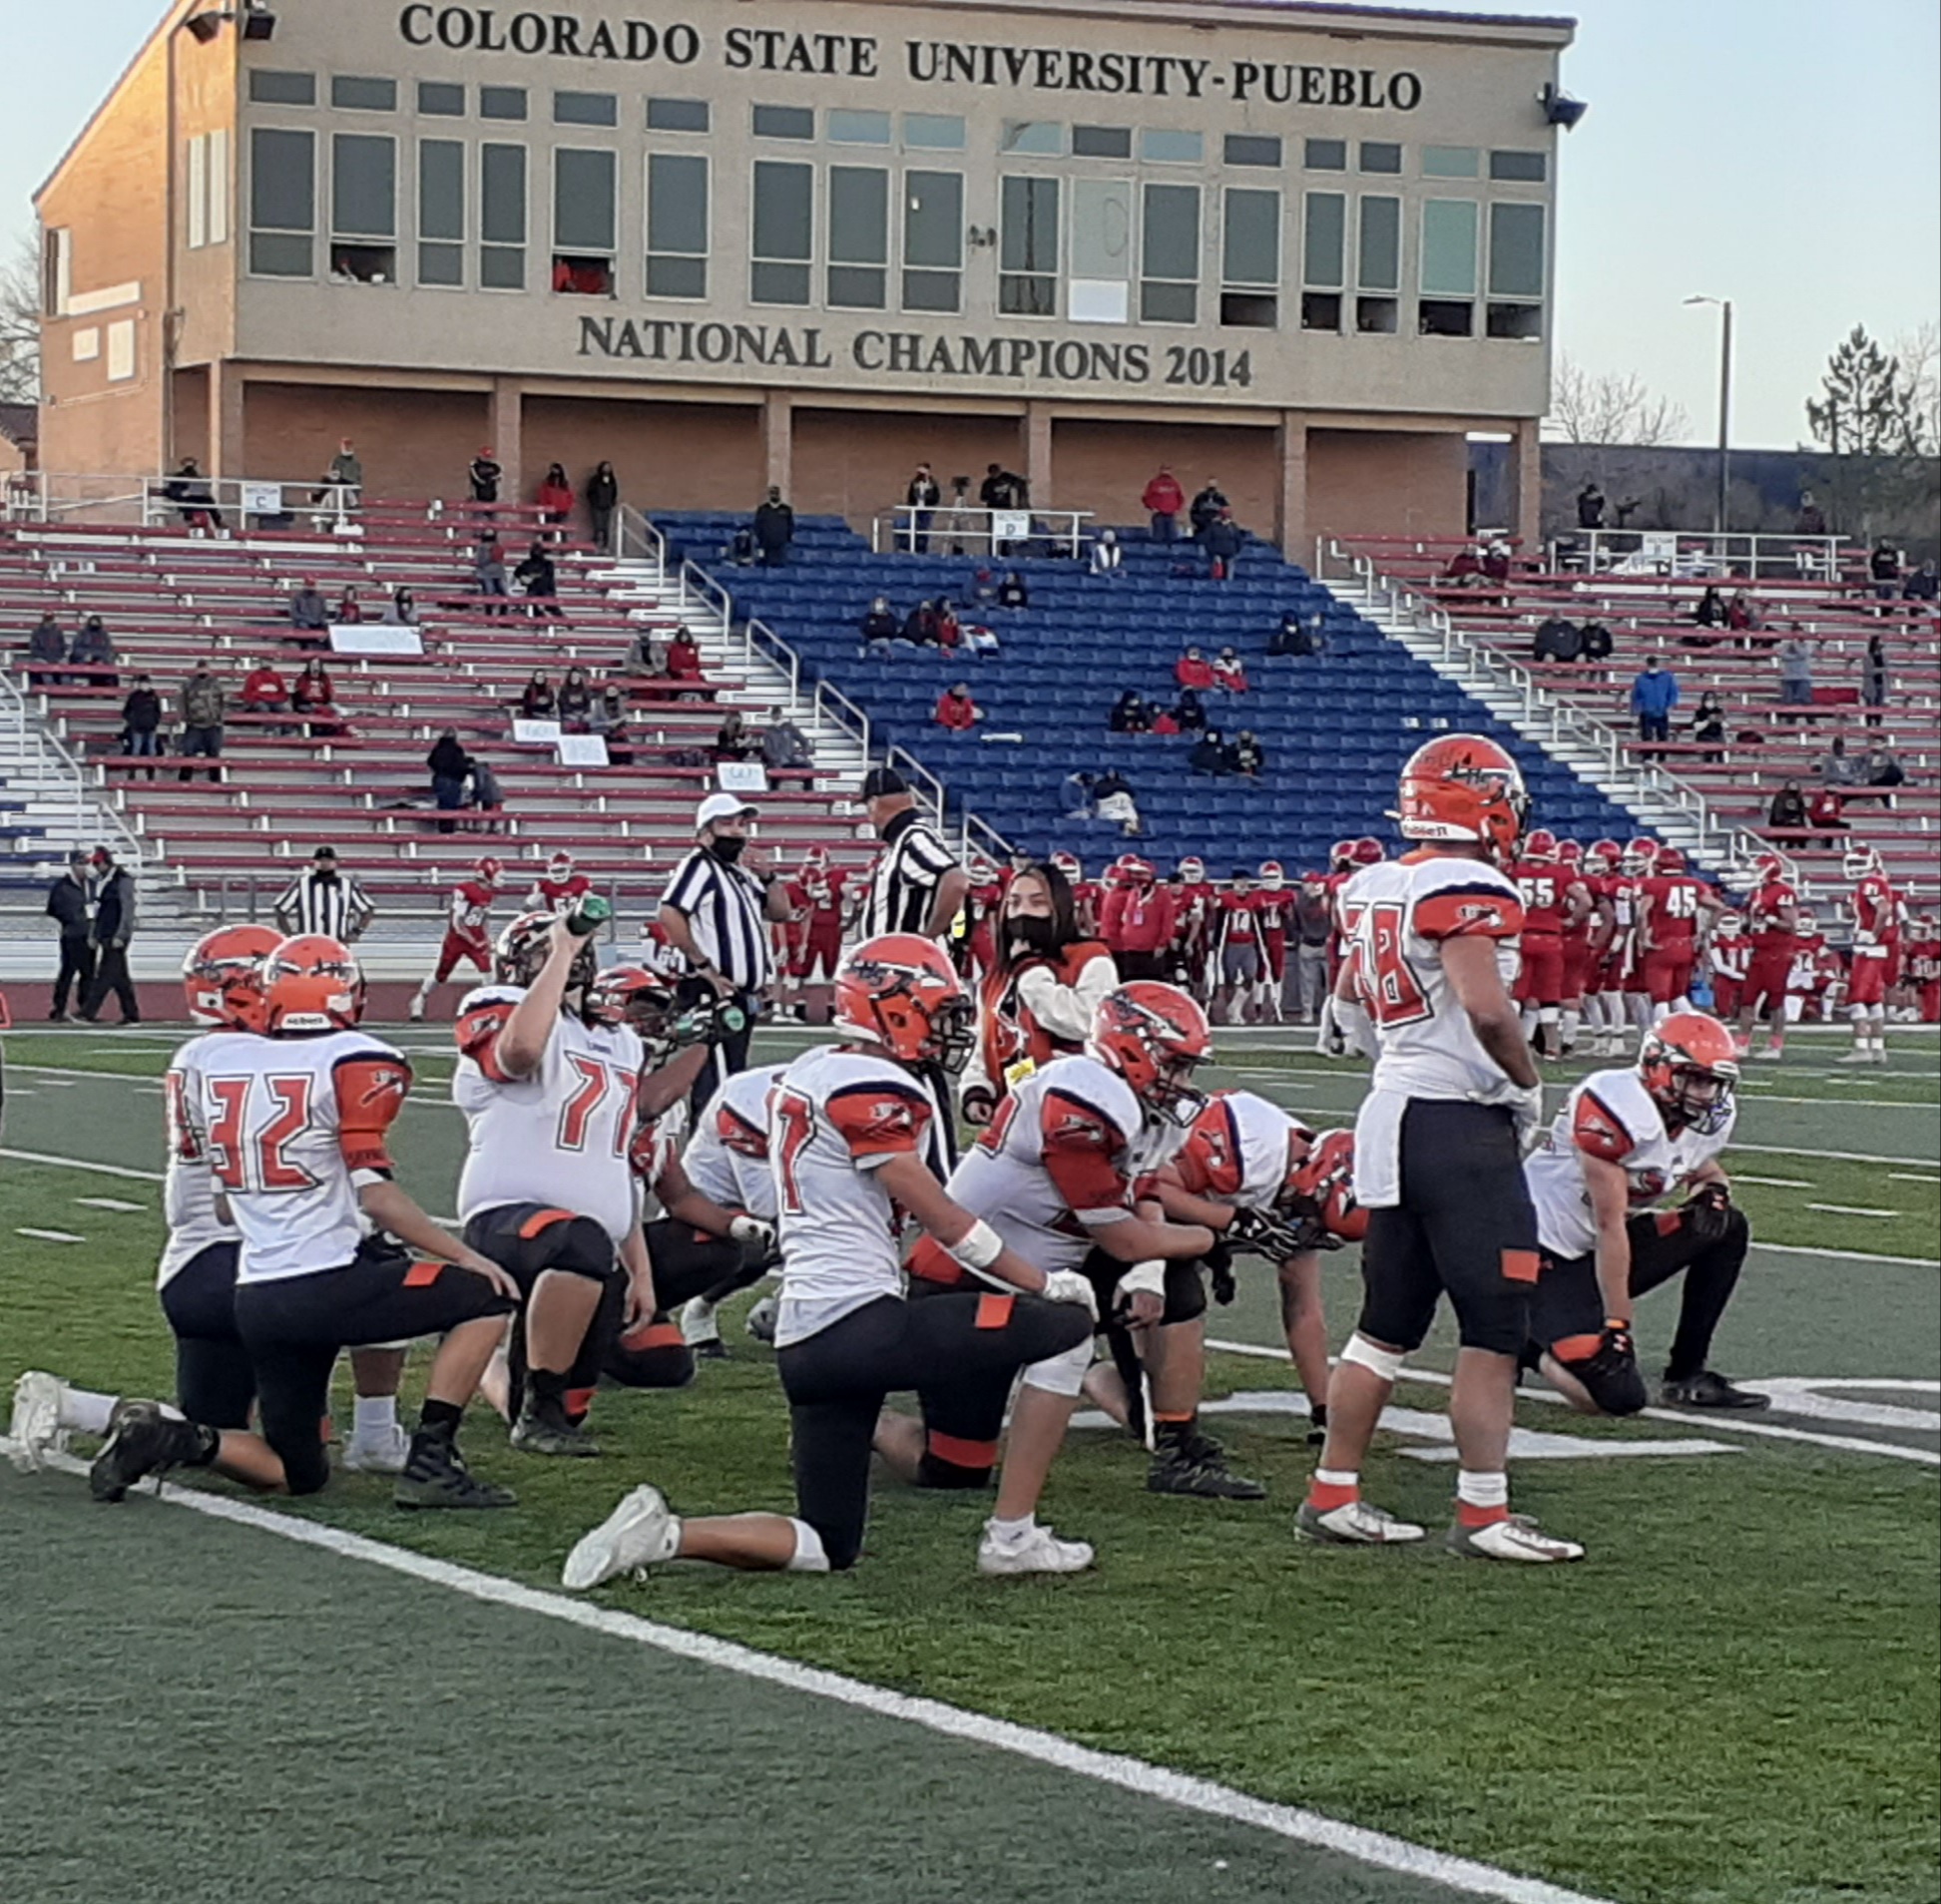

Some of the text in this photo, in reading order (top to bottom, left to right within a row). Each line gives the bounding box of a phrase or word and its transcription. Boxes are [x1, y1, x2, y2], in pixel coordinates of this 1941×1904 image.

[399, 3, 1422, 112] COLORADO STATE UNIVERSITY-PUEBLO
[578, 315, 1252, 387] NATIONAL CHAMPIONS 2014
[1516, 877, 1555, 908] 55
[1665, 885, 1697, 918] 45
[205, 1072, 325, 1194] 32
[556, 1049, 638, 1160] 77
